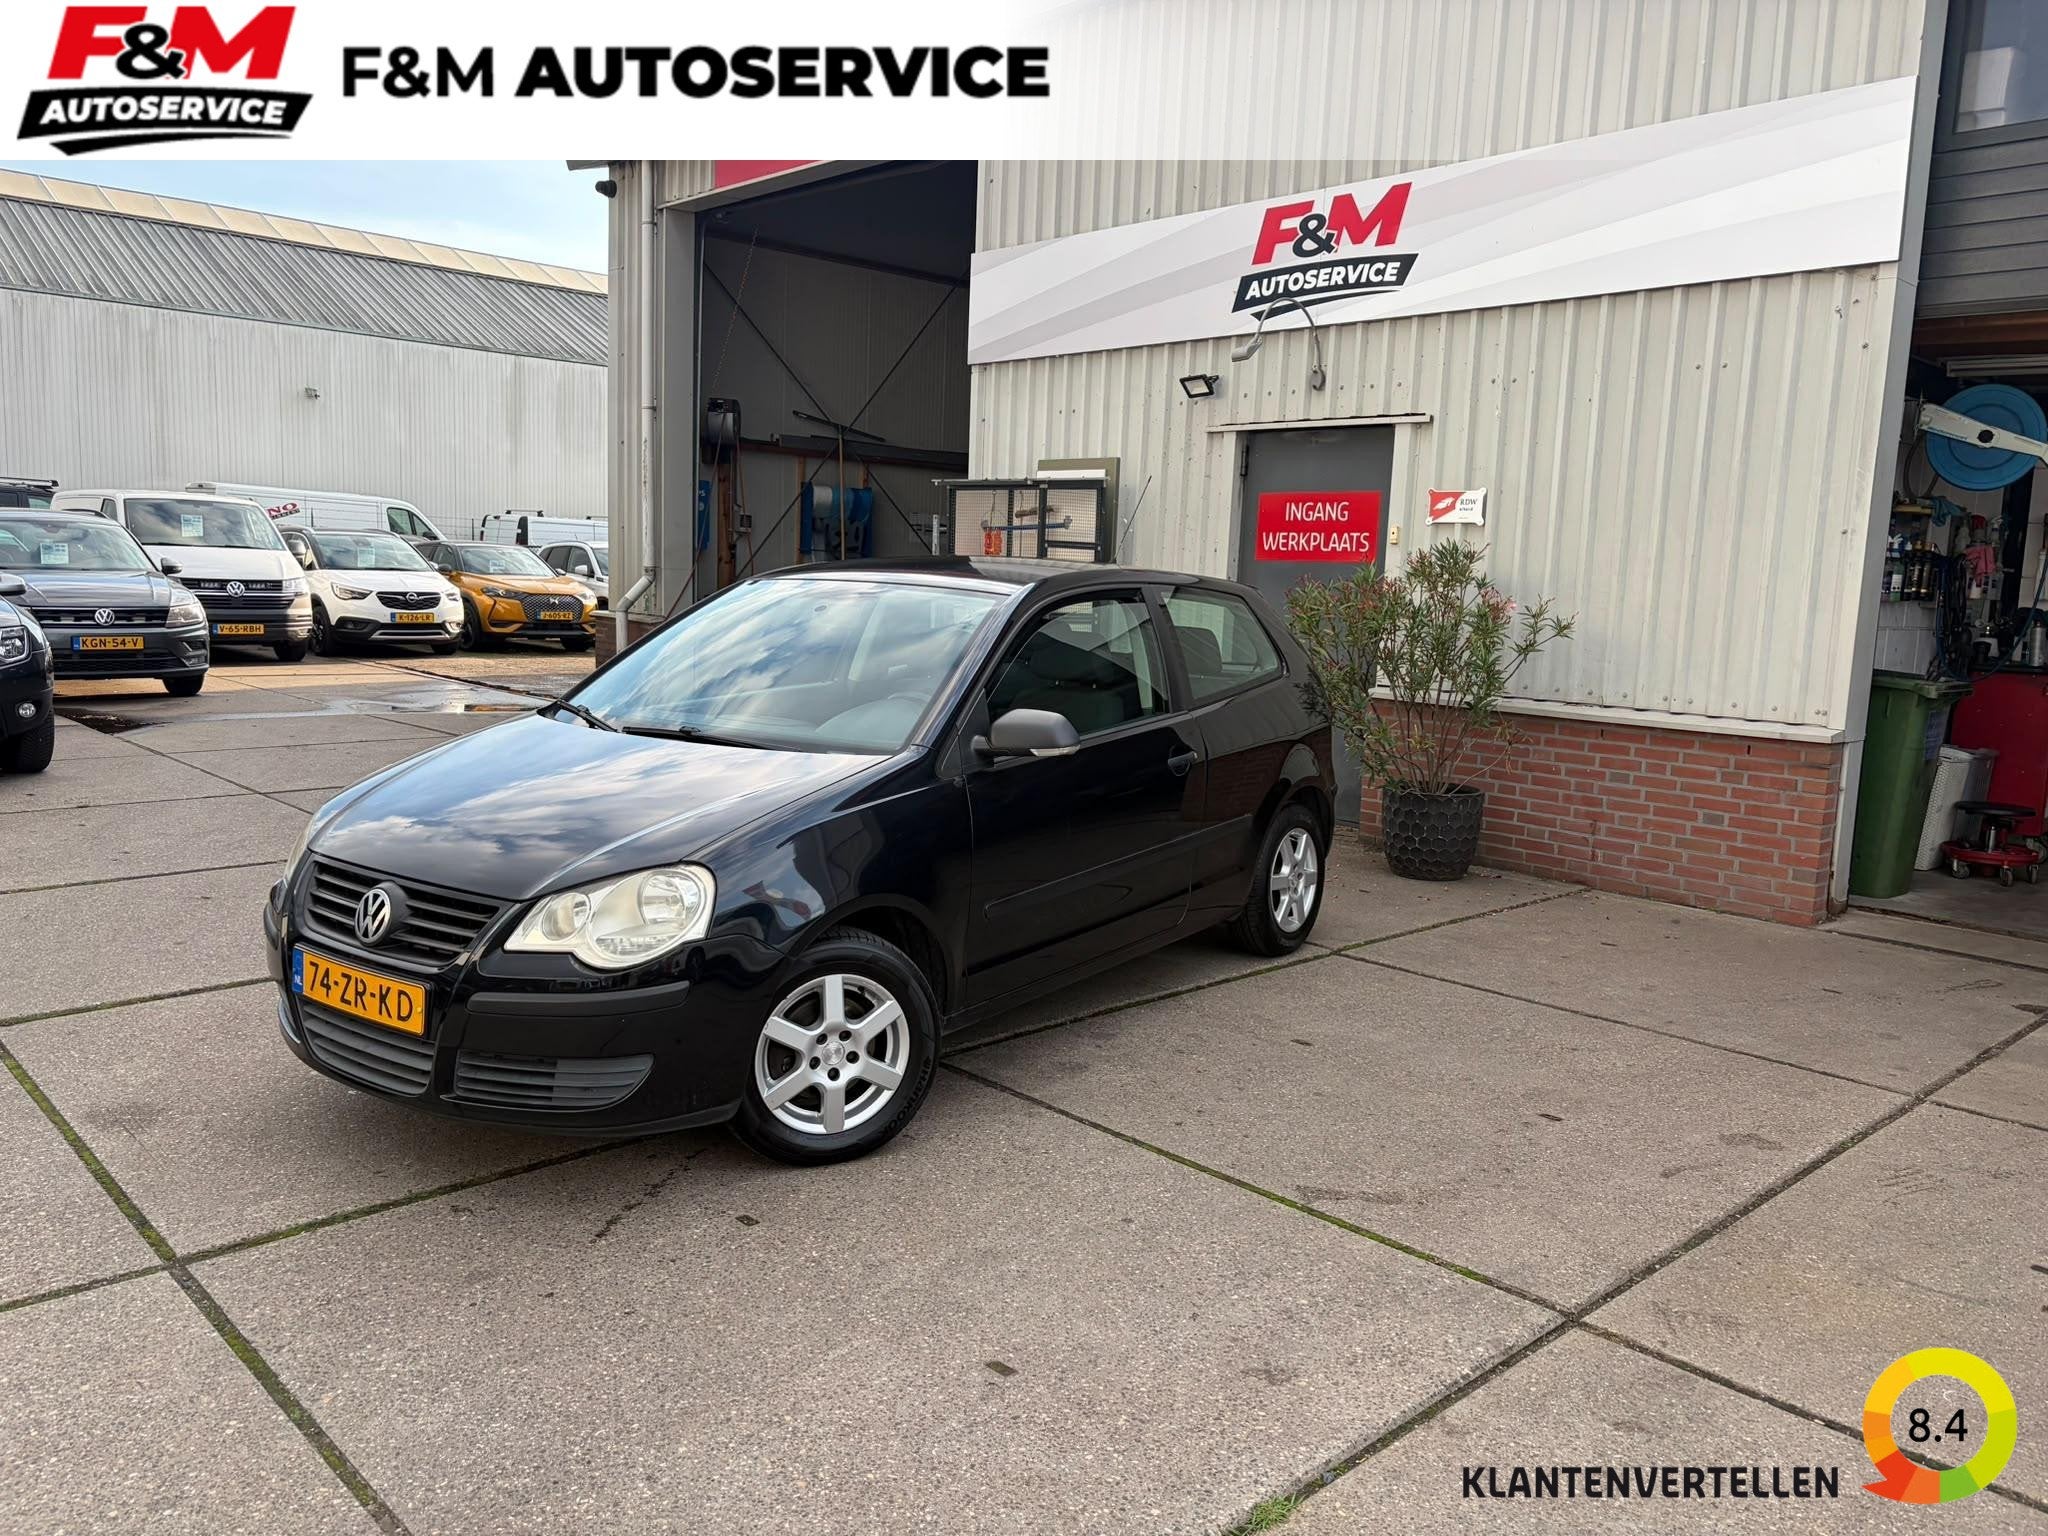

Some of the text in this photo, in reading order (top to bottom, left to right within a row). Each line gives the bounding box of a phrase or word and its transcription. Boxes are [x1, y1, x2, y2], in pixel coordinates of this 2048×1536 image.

[1251, 182, 1412, 265] F&M
[1244, 261, 1401, 301] AUTOSERVICE
[1285, 501, 1350, 522] INGANG
[1262, 532, 1370, 552] WERKPLAATS
[219, 625, 261, 633] V-65-RBH
[81, 638, 140, 648] KGN-54-V
[309, 960, 413, 1022] 74-ZR-KD
